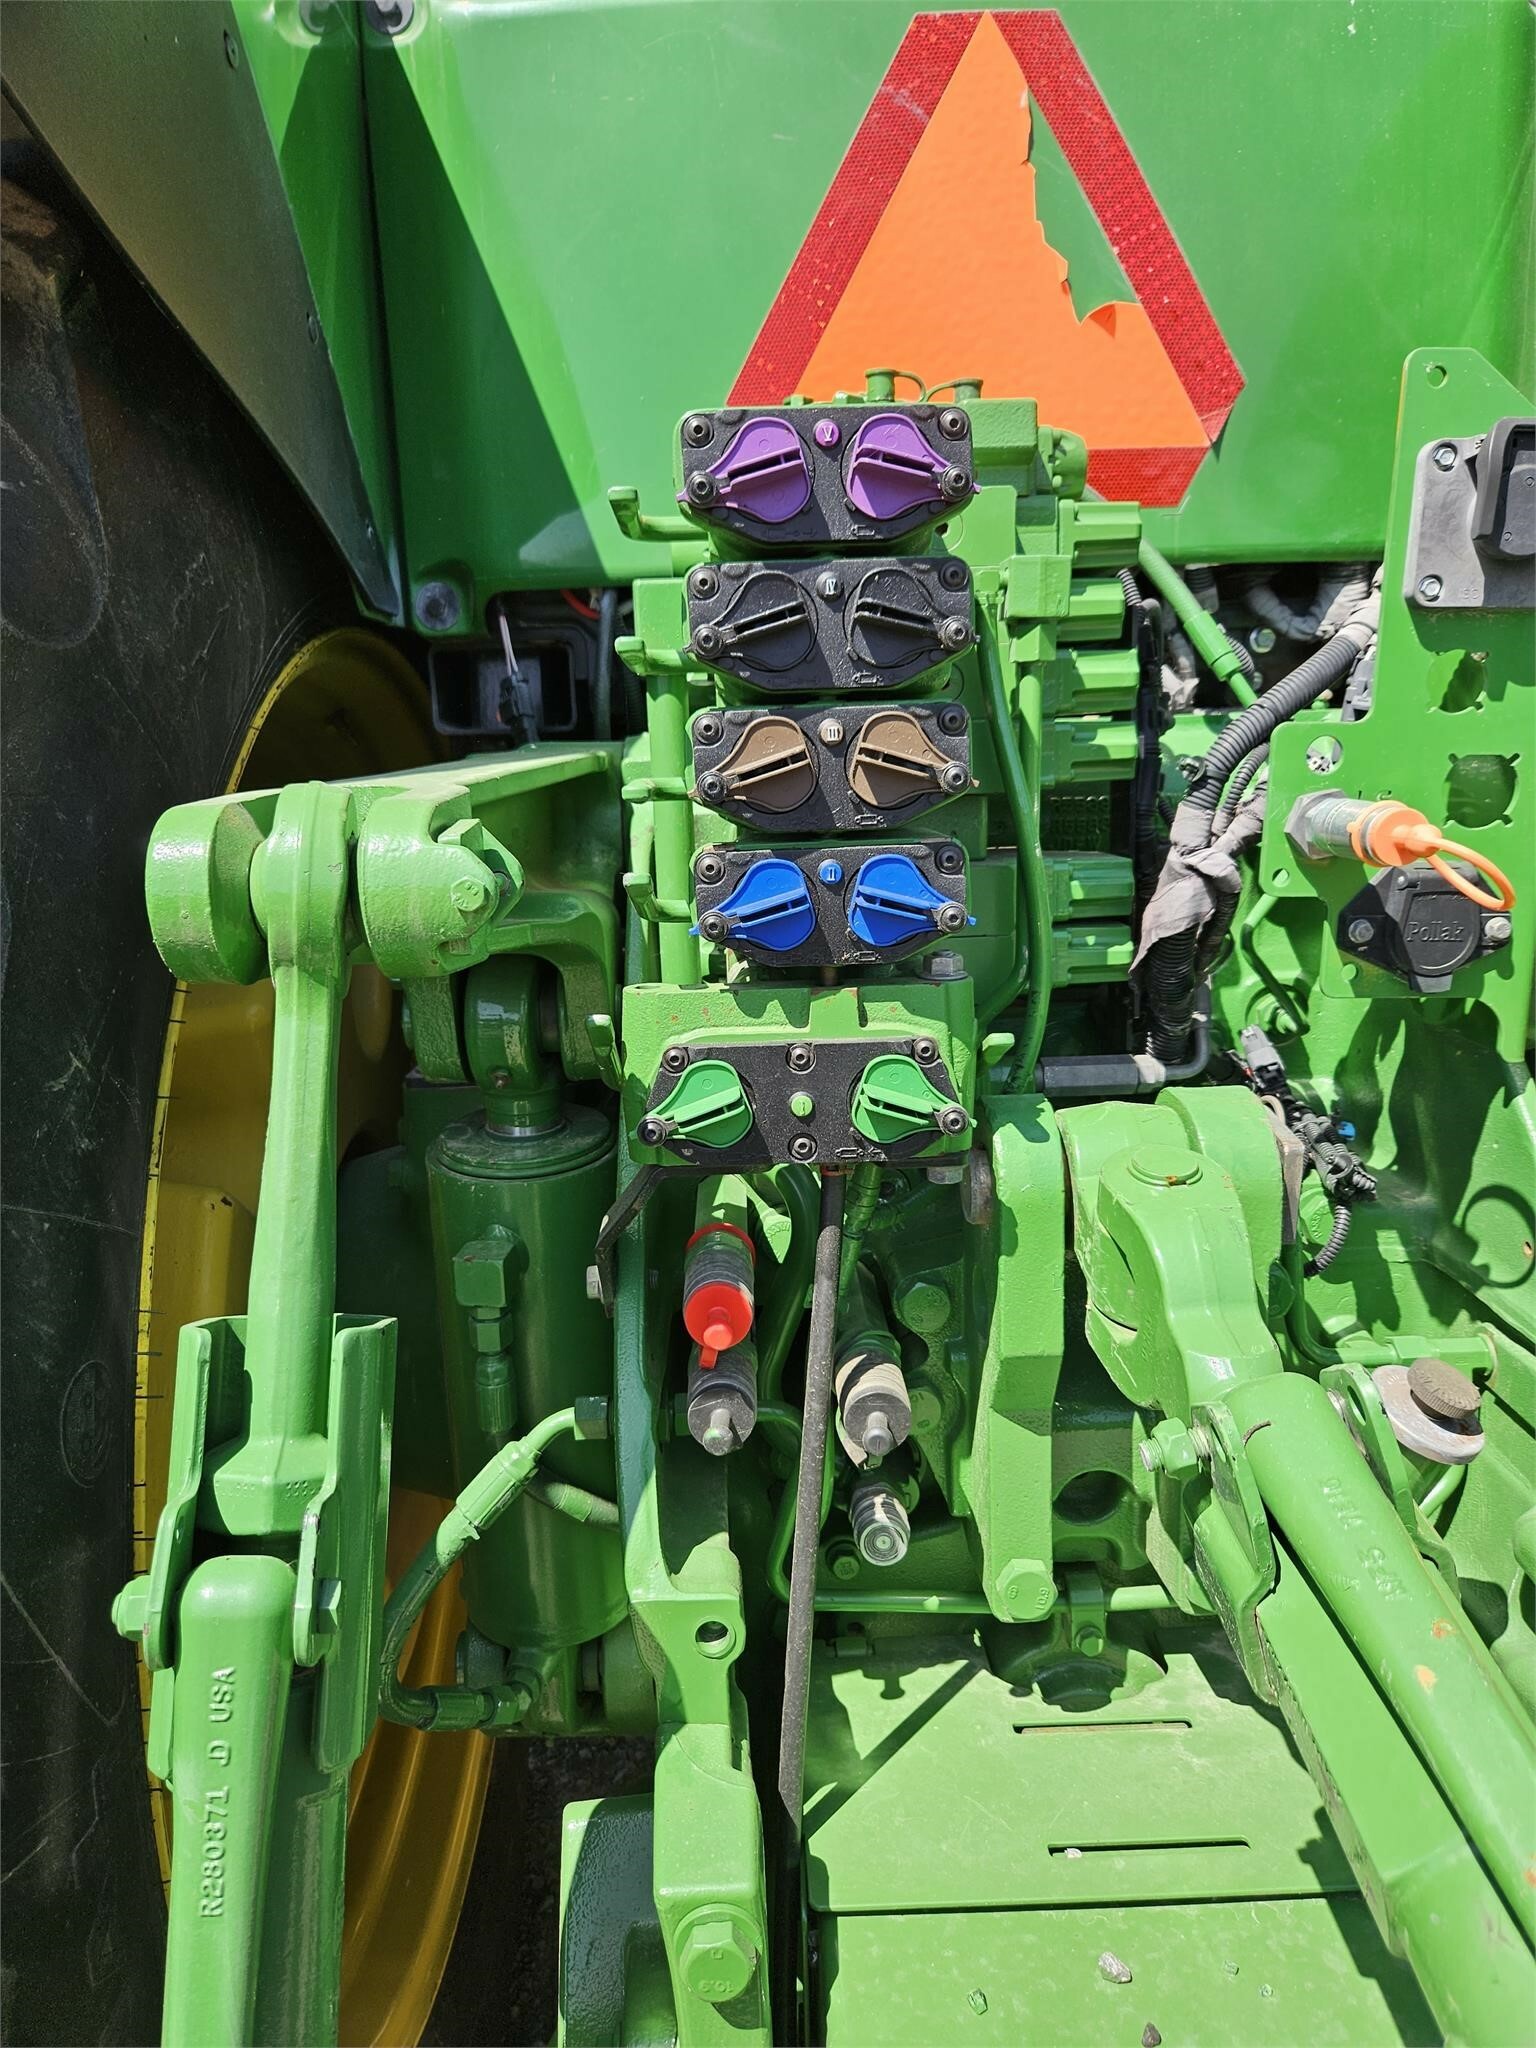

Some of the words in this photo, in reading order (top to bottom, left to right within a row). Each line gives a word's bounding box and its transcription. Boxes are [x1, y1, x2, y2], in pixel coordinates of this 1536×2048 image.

[823, 426, 834, 442] V
[826, 578, 838, 595] IV
[828, 727, 842, 741] III
[827, 867, 838, 881] II
[1405, 920, 1465, 942] Pollak
[207, 1666, 237, 1723] USA
[199, 1785, 230, 1918] R280371
